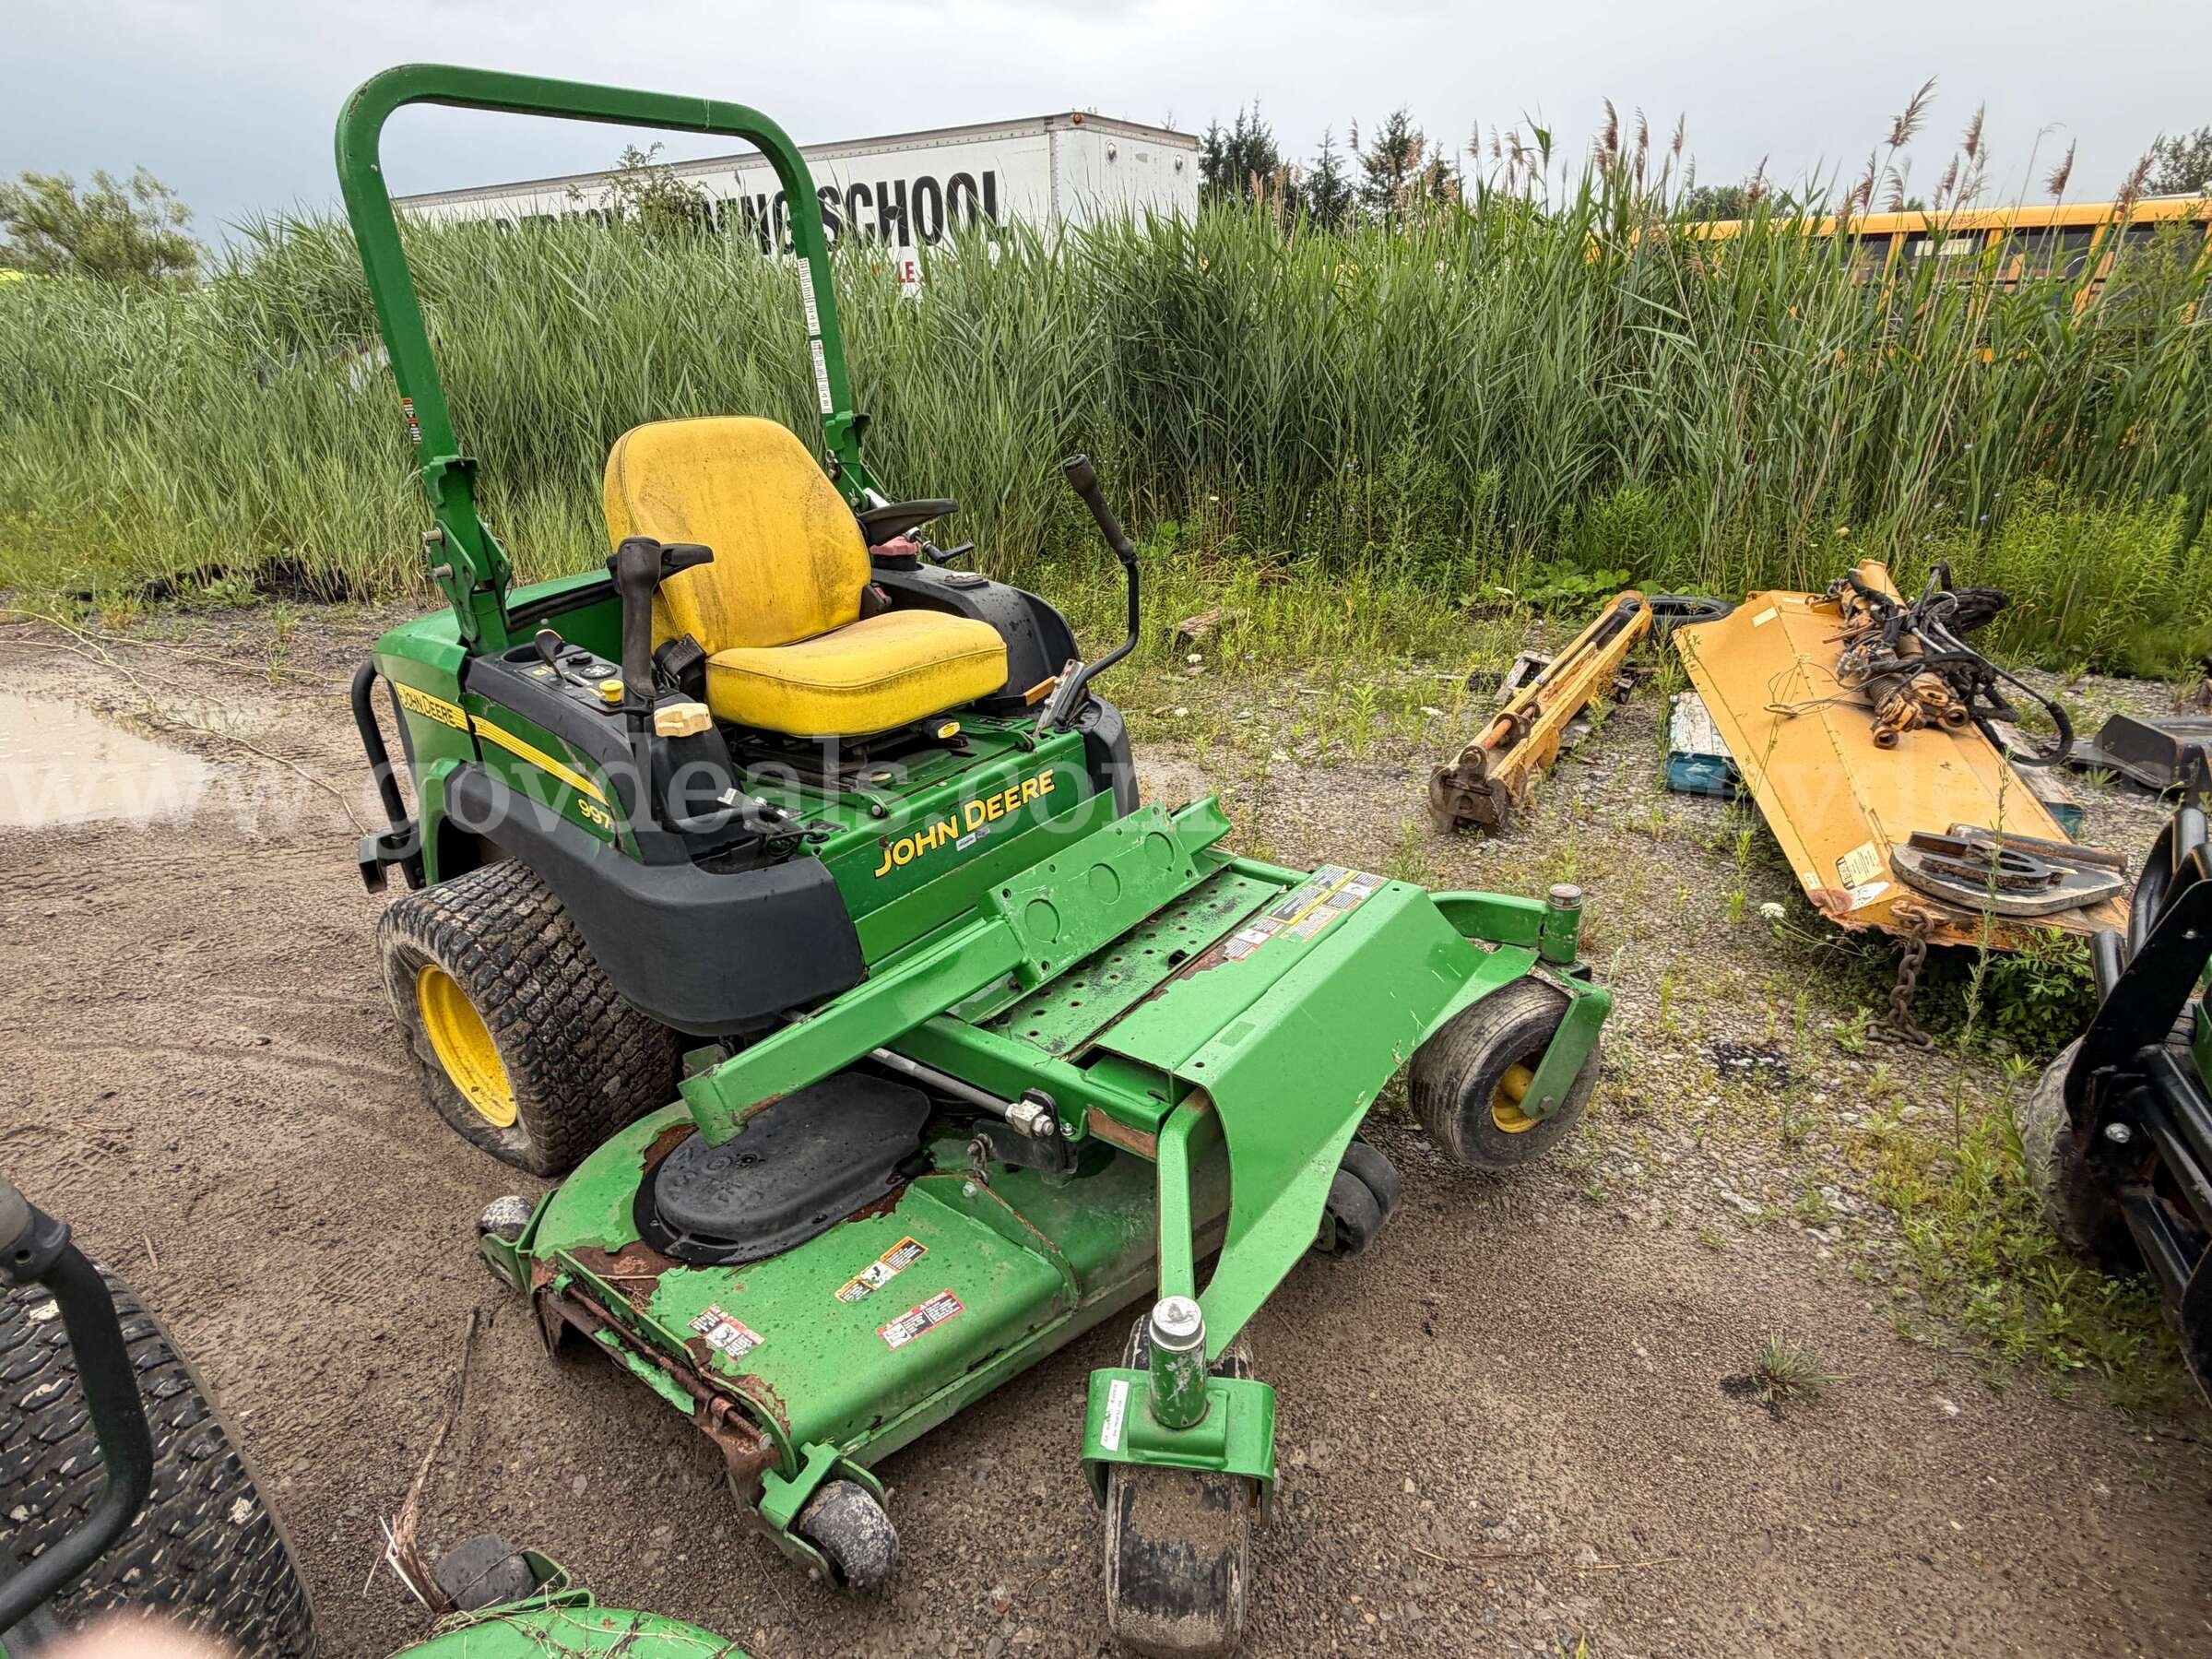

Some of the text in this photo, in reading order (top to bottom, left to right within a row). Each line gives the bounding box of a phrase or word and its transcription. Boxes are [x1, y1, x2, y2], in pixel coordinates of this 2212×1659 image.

[817, 170, 1013, 253] SCHOOL
[398, 688, 457, 729] JOHN DEERE
[577, 798, 610, 830] 997
[874, 768, 1056, 877] JOHN DEERE
